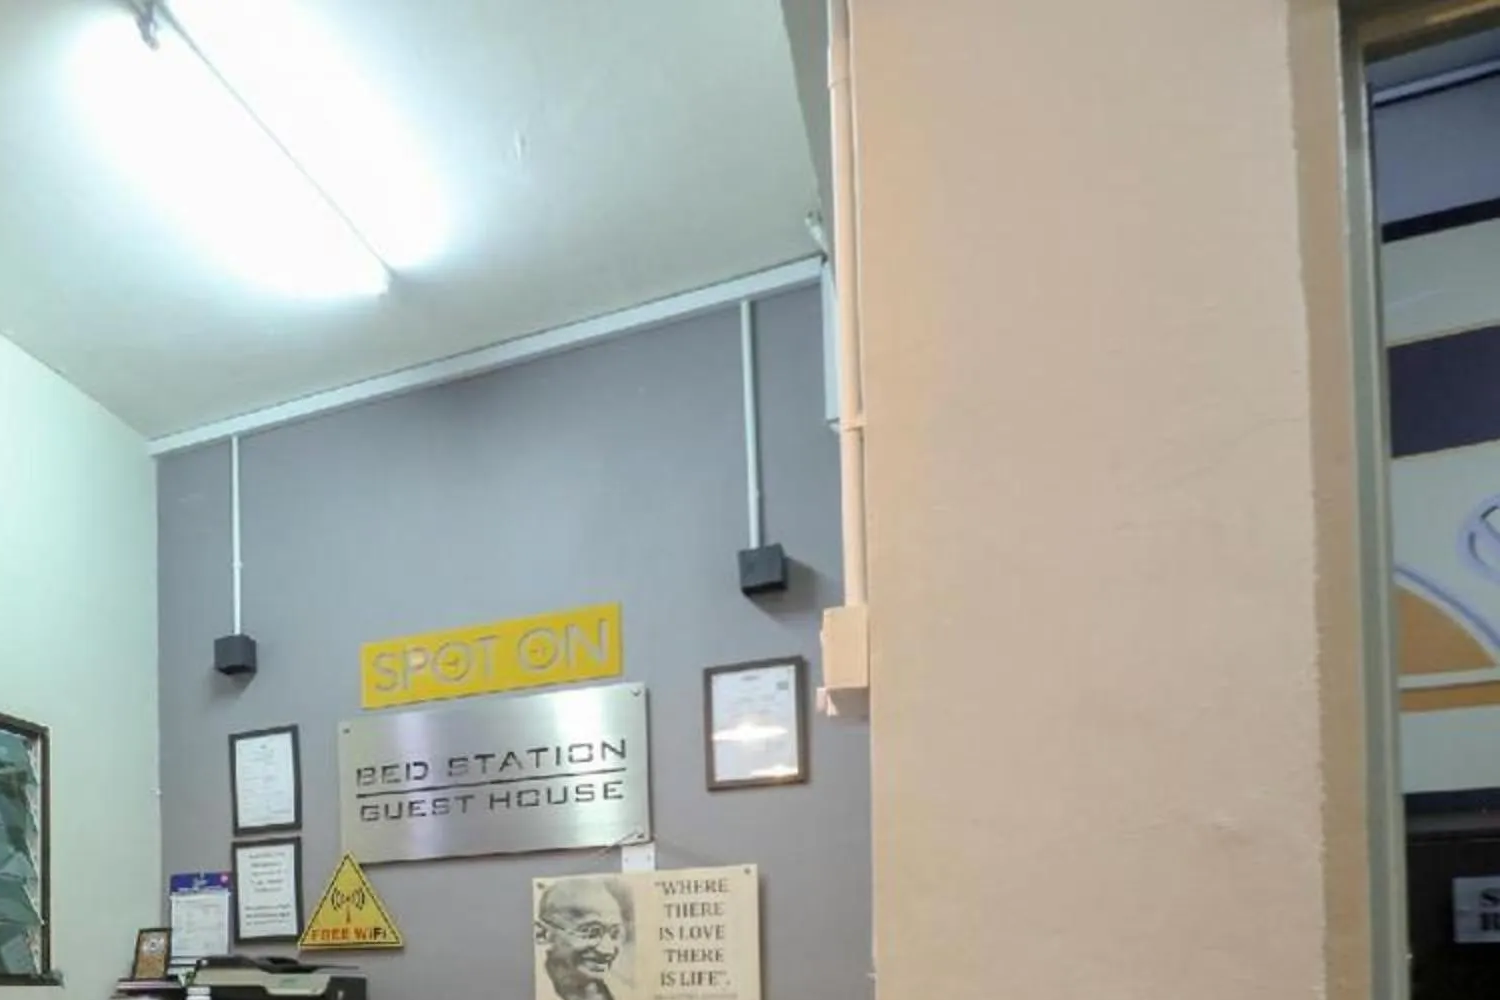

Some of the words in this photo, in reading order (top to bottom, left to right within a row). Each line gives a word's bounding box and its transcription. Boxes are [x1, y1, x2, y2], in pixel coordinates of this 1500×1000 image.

[372, 634, 501, 693] SPOT
[517, 618, 609, 671] ON
[356, 761, 429, 787] BED
[448, 739, 627, 777] STATION
[360, 795, 475, 821] GUEST
[489, 781, 624, 810] HOUSE
[664, 901, 726, 918] THERE
[311, 928, 348, 941] FREE
[659, 926, 676, 941] IS
[679, 924, 726, 941] LOVE
[663, 948, 725, 963] THERE
[660, 971, 677, 987] IS
